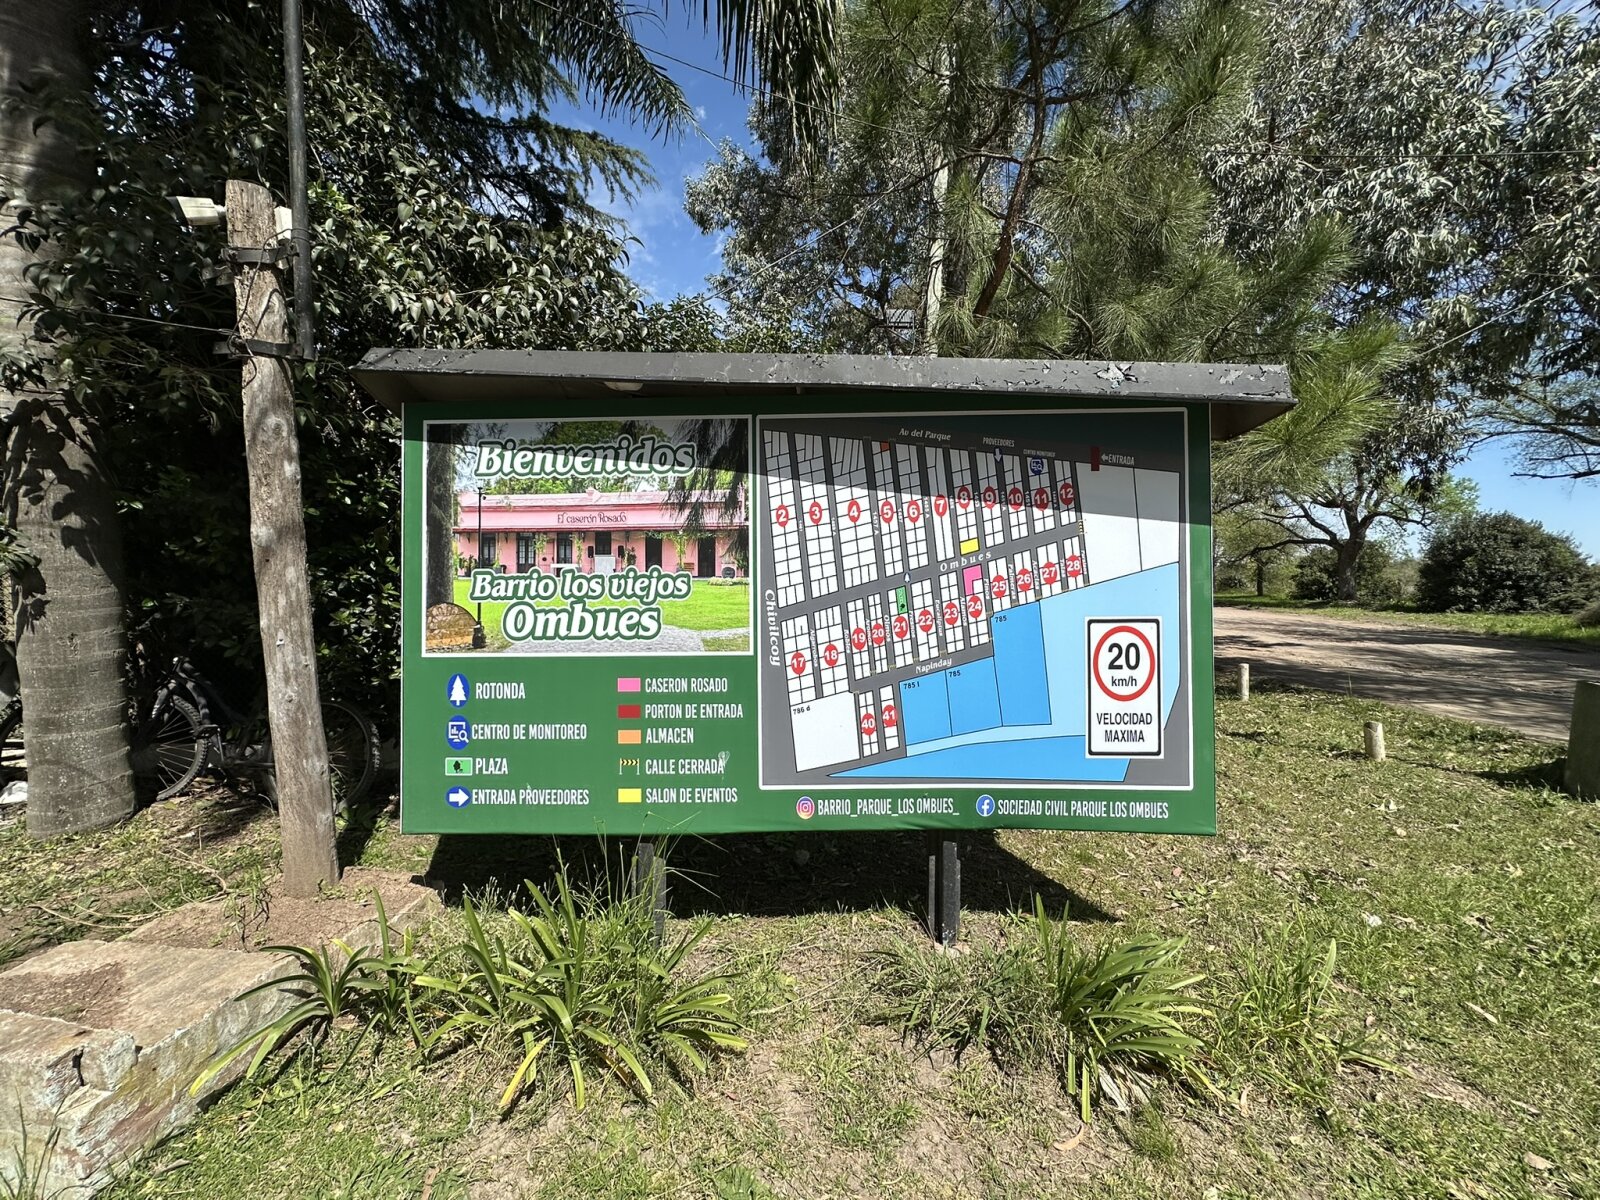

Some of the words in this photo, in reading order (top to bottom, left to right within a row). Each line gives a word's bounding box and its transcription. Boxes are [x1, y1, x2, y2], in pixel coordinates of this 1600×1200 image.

[899, 428, 909, 436] Av
[911, 429, 922, 438] del
[924, 430, 952, 441] Parque
[982, 437, 1015, 448] PROVEEDORES
[476, 436, 697, 476] Bienvenidos
[1108, 454, 1134, 466] ENTRADA
[961, 491, 970, 504] 8
[986, 492, 994, 504] 9
[1008, 493, 1021, 504] 10
[1035, 493, 1048, 504] 11
[1060, 488, 1074, 499] 12
[936, 500, 945, 511] 7
[557, 512, 566, 524] El
[599, 512, 627, 524] Rosado
[778, 510, 786, 522] 2
[812, 506, 820, 519] 3
[850, 506, 858, 518] 4
[884, 506, 892, 518] 5
[909, 506, 918, 518] 6
[940, 550, 992, 572] Ombues
[1066, 560, 1081, 570] 28
[1042, 568, 1056, 578] 27
[471, 568, 556, 599] Barrio
[562, 567, 605, 599] los
[609, 566, 692, 602] viejos
[1017, 574, 1031, 585] 26
[992, 582, 1006, 592] 25
[968, 600, 982, 612] 24
[944, 608, 958, 619] 23
[503, 602, 662, 640] Ombues
[918, 615, 932, 626] 22
[764, 589, 780, 666] Chivilcoy
[872, 628, 884, 638] 20
[894, 622, 908, 632] 21
[852, 634, 866, 644] 19
[824, 650, 838, 660] 18
[1108, 642, 1140, 670] 20
[791, 658, 805, 668] 17
[916, 658, 952, 674] Napinday
[948, 670, 961, 678] 785
[645, 678, 688, 693] CASERON
[691, 678, 728, 692] ROSADO
[904, 682, 915, 690] 785
[1111, 676, 1137, 687] km/h
[476, 682, 526, 700] ROTONDA
[645, 704, 683, 719] PORTON
[685, 704, 698, 719] DE
[700, 704, 744, 718] ENTRADA
[882, 710, 896, 720] 41
[862, 718, 875, 728] 40
[1096, 712, 1152, 725] VELOCIDAD
[472, 724, 510, 740] CENTRO
[513, 724, 526, 740] DE
[529, 724, 587, 740] MONITOREO
[646, 728, 694, 744] ALMACEN
[1104, 730, 1145, 742] MAXIMA
[476, 758, 508, 775] PLAZA
[646, 759, 676, 774] CALLE
[678, 758, 724, 774] CERRADA
[472, 790, 516, 806] ENTRADA
[519, 788, 589, 805] PROVEEDORES
[646, 788, 676, 803] SALON
[679, 788, 692, 803] DE
[695, 788, 738, 803] EVENTOS
[998, 799, 1042, 816] SOCIEDAD
[1045, 800, 1068, 816] CIVIL
[1070, 800, 1107, 818] PARQUE
[1110, 802, 1128, 818] LOS
[1129, 802, 1169, 818] OMBUES
